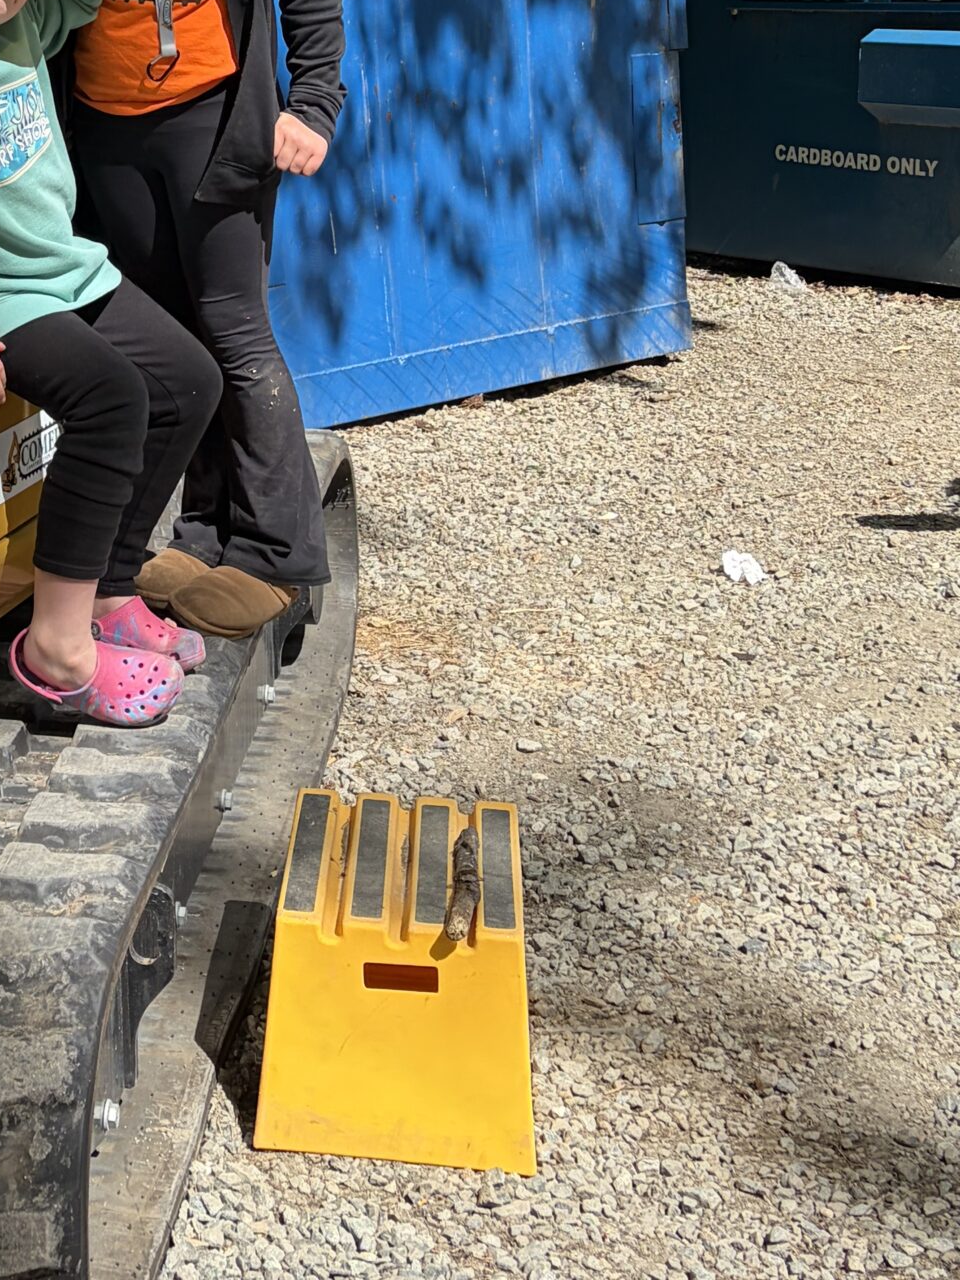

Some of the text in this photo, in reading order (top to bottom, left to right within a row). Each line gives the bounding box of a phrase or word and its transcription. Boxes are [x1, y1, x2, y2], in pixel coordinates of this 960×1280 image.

[15, 117, 50, 151] SHOP
[775, 144, 939, 177] CARDBOARD ONLY
